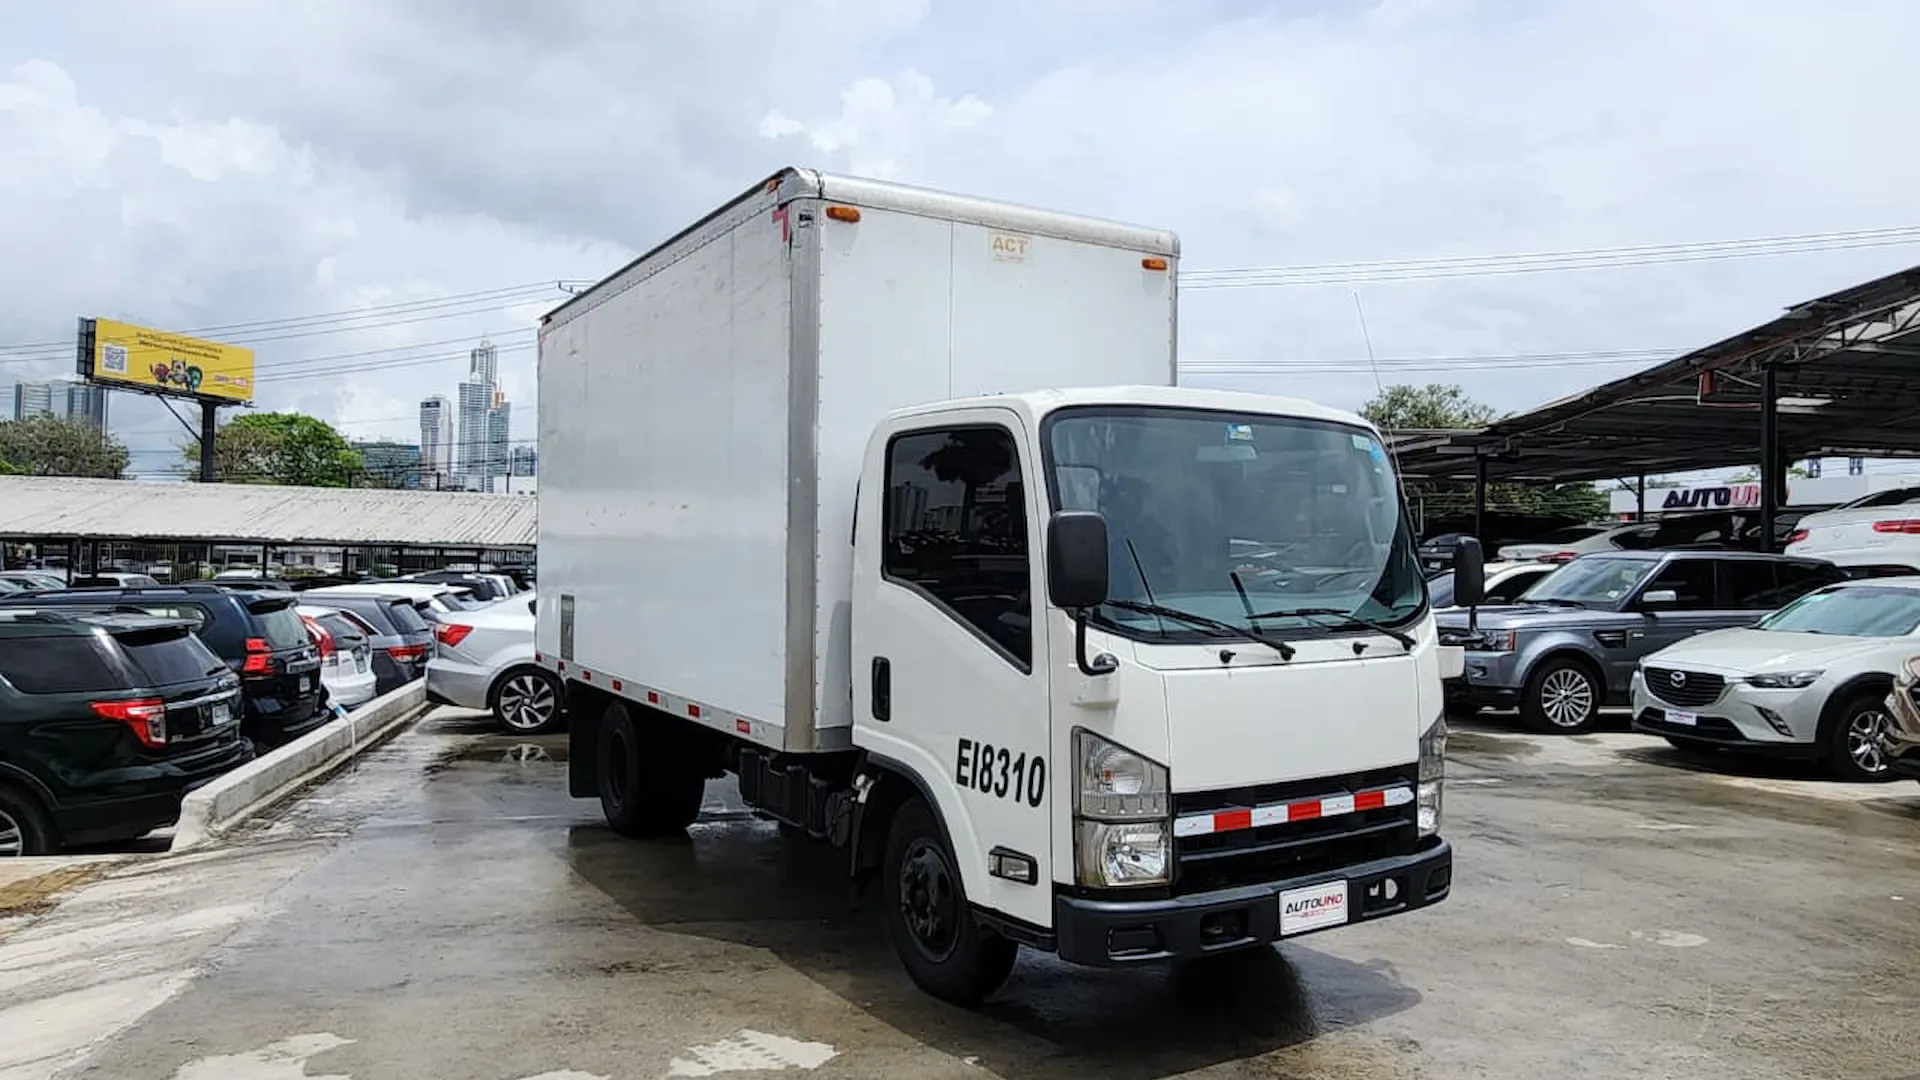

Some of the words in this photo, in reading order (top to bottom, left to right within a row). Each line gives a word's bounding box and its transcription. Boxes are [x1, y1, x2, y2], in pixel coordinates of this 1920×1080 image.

[992, 236, 1029, 254] ACT
[1662, 485, 1760, 508] AUTOU
[956, 737, 1045, 808] EI8310
[1285, 893, 1343, 914] AUTOUNO
